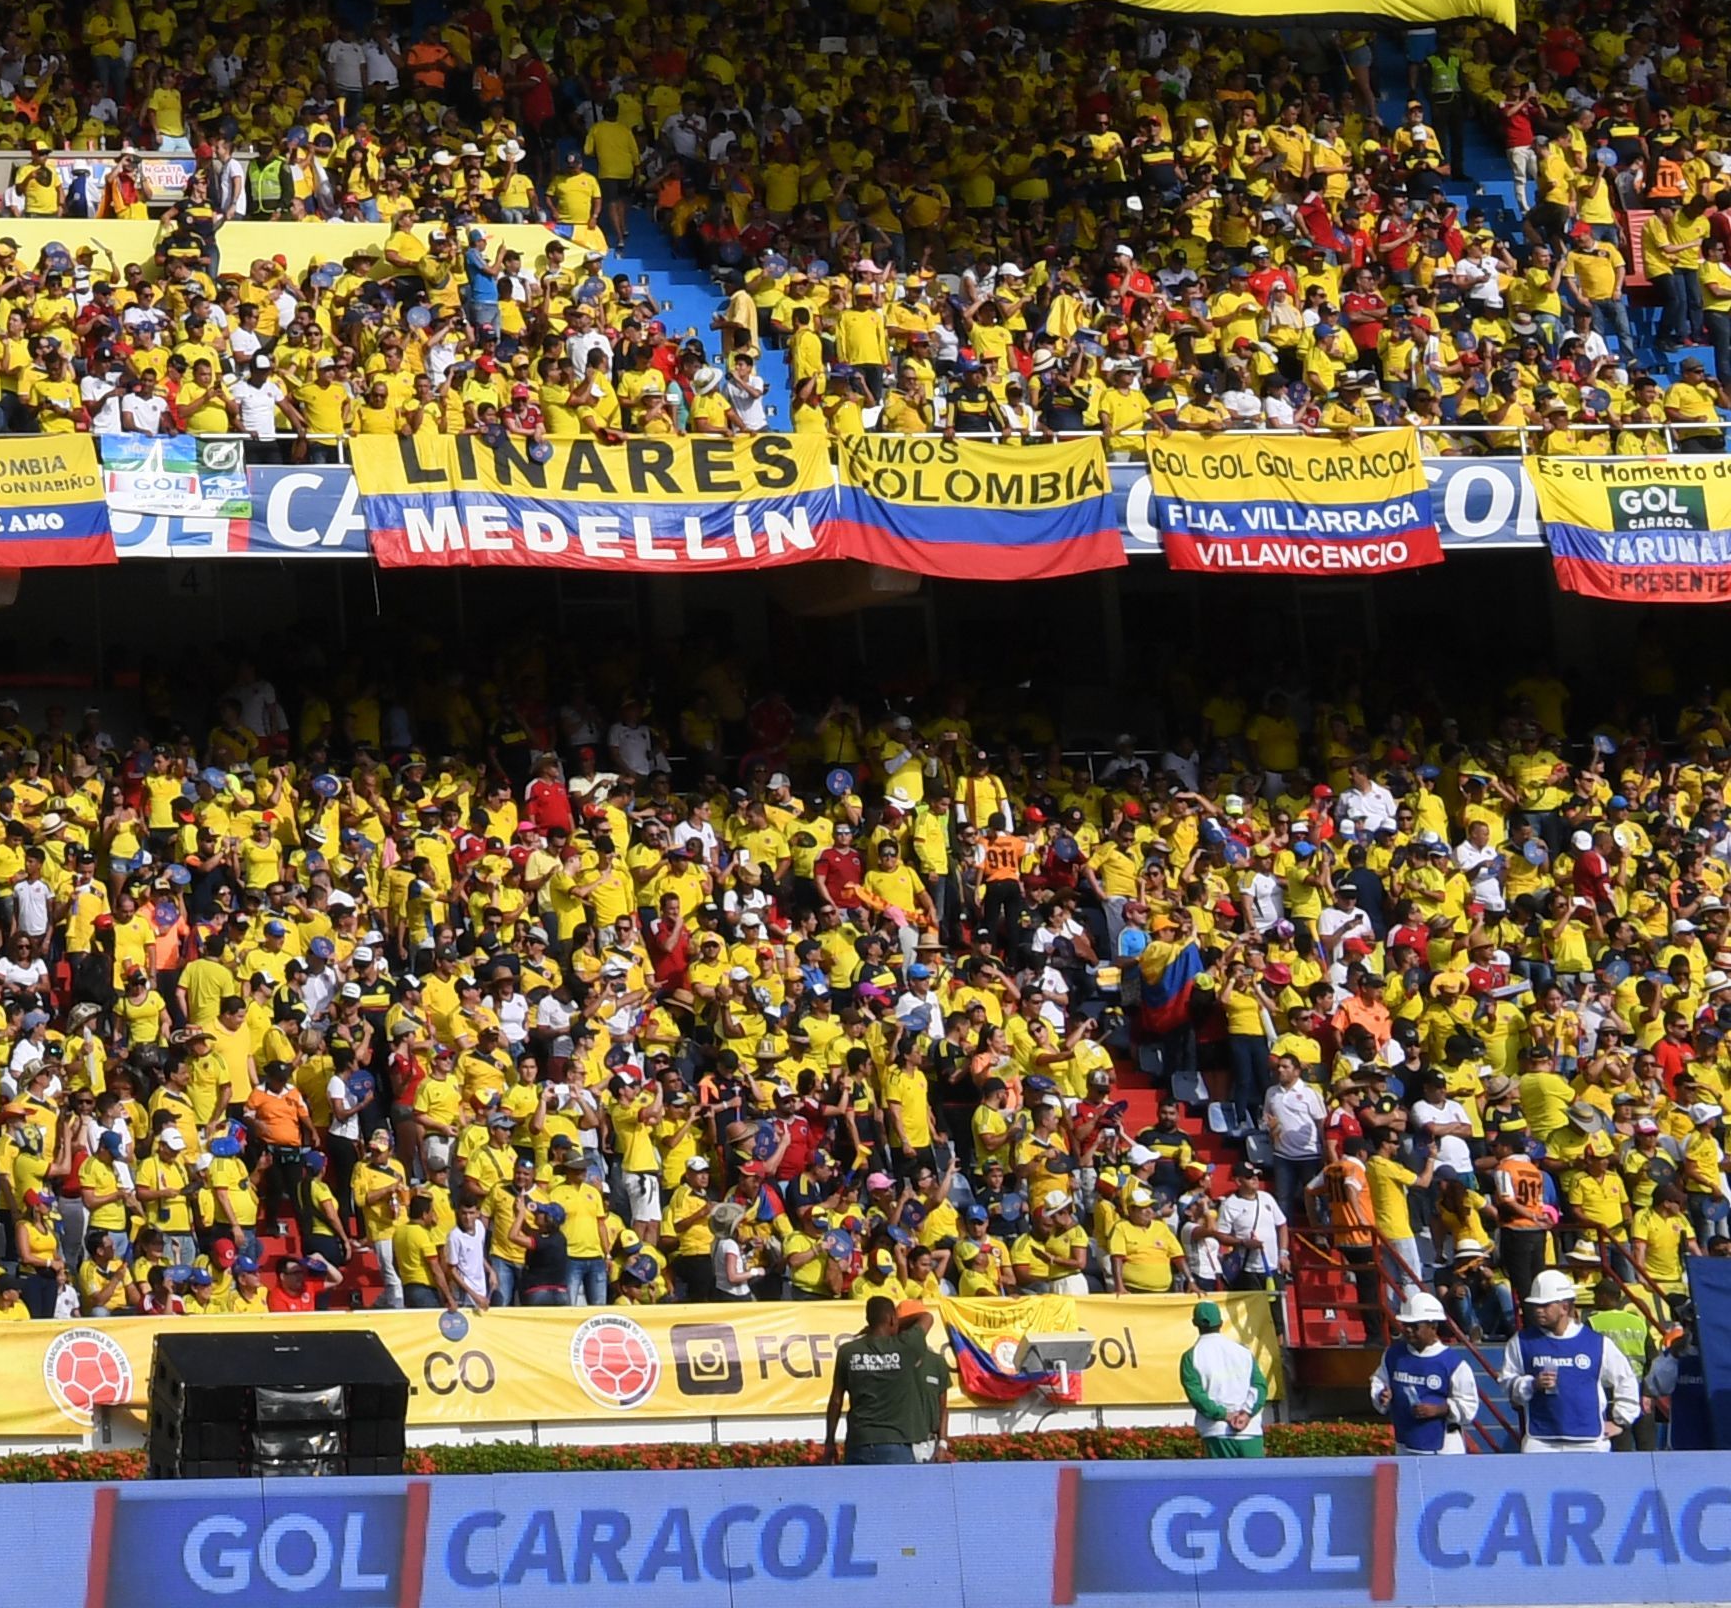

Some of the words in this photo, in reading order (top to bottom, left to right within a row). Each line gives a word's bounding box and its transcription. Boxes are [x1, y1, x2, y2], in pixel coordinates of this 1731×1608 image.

[399, 434, 799, 494] LINARES
[1202, 452, 1253, 480] GOL
[1256, 450, 1304, 481] GOL
[1572, 464, 1593, 482] el
[1600, 463, 1707, 482] Momento
[29, 473, 96, 492] NARIÑO
[134, 477, 188, 491] GOL
[1618, 486, 1689, 514] GOL
[7, 512, 65, 533] AMO
[403, 503, 817, 559] MEDELLÍN
[1242, 501, 1419, 533] VILLARRAGA
[1628, 516, 1693, 529] CARACOL
[1195, 541, 1409, 570] VILLAVICENCIO
[986, 849, 1017, 871] 911
[446, 1502, 878, 1589] CARACOL
[1149, 1493, 1362, 1575] GOL
[182, 1510, 390, 1595] GOL
